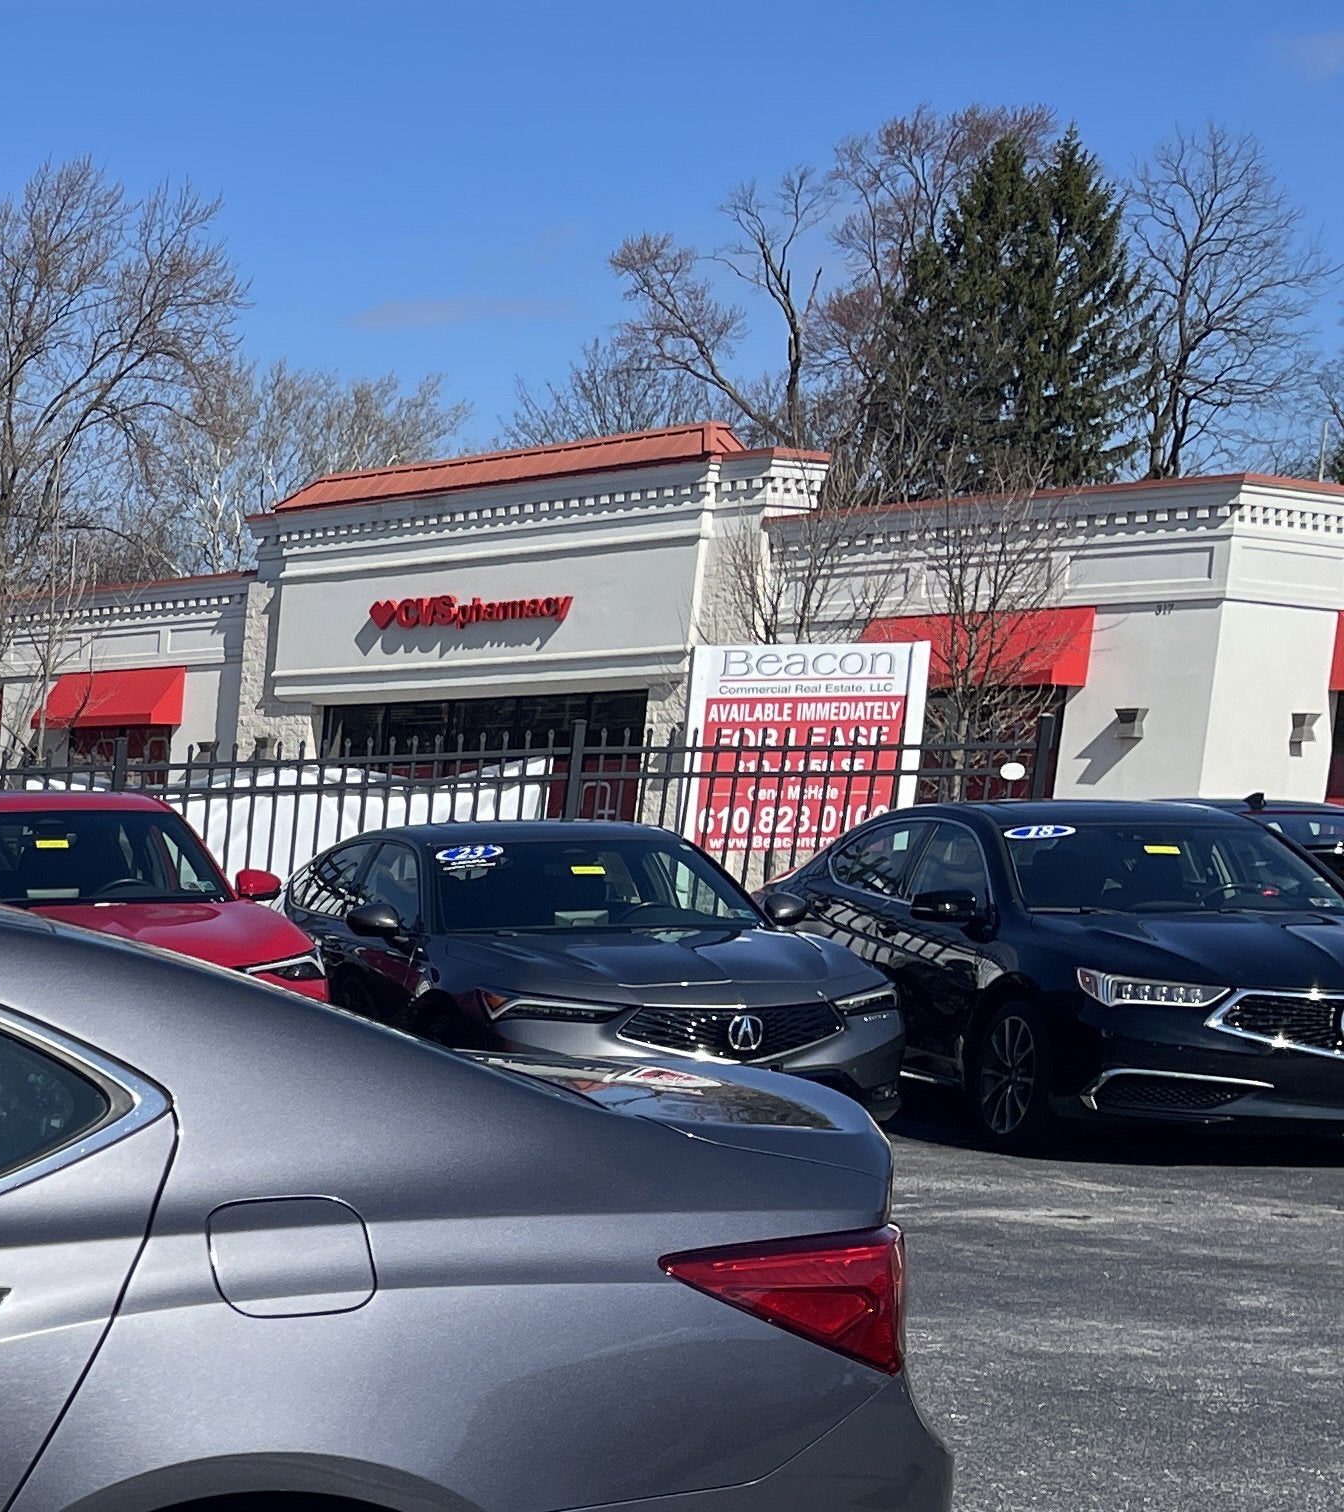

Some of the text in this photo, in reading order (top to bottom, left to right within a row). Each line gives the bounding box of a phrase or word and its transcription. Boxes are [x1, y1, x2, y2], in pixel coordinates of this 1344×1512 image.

[396, 595, 574, 630] CVS pharmacy
[1155, 603, 1174, 617] 317
[720, 649, 896, 677] Beacon
[719, 682, 894, 695] Commercial Real Estate, LLC
[708, 701, 902, 723] AVAILABLE IMMEDIATELY
[747, 785, 786, 801] Gen
[1025, 825, 1055, 839] 18
[454, 845, 486, 861] 23
